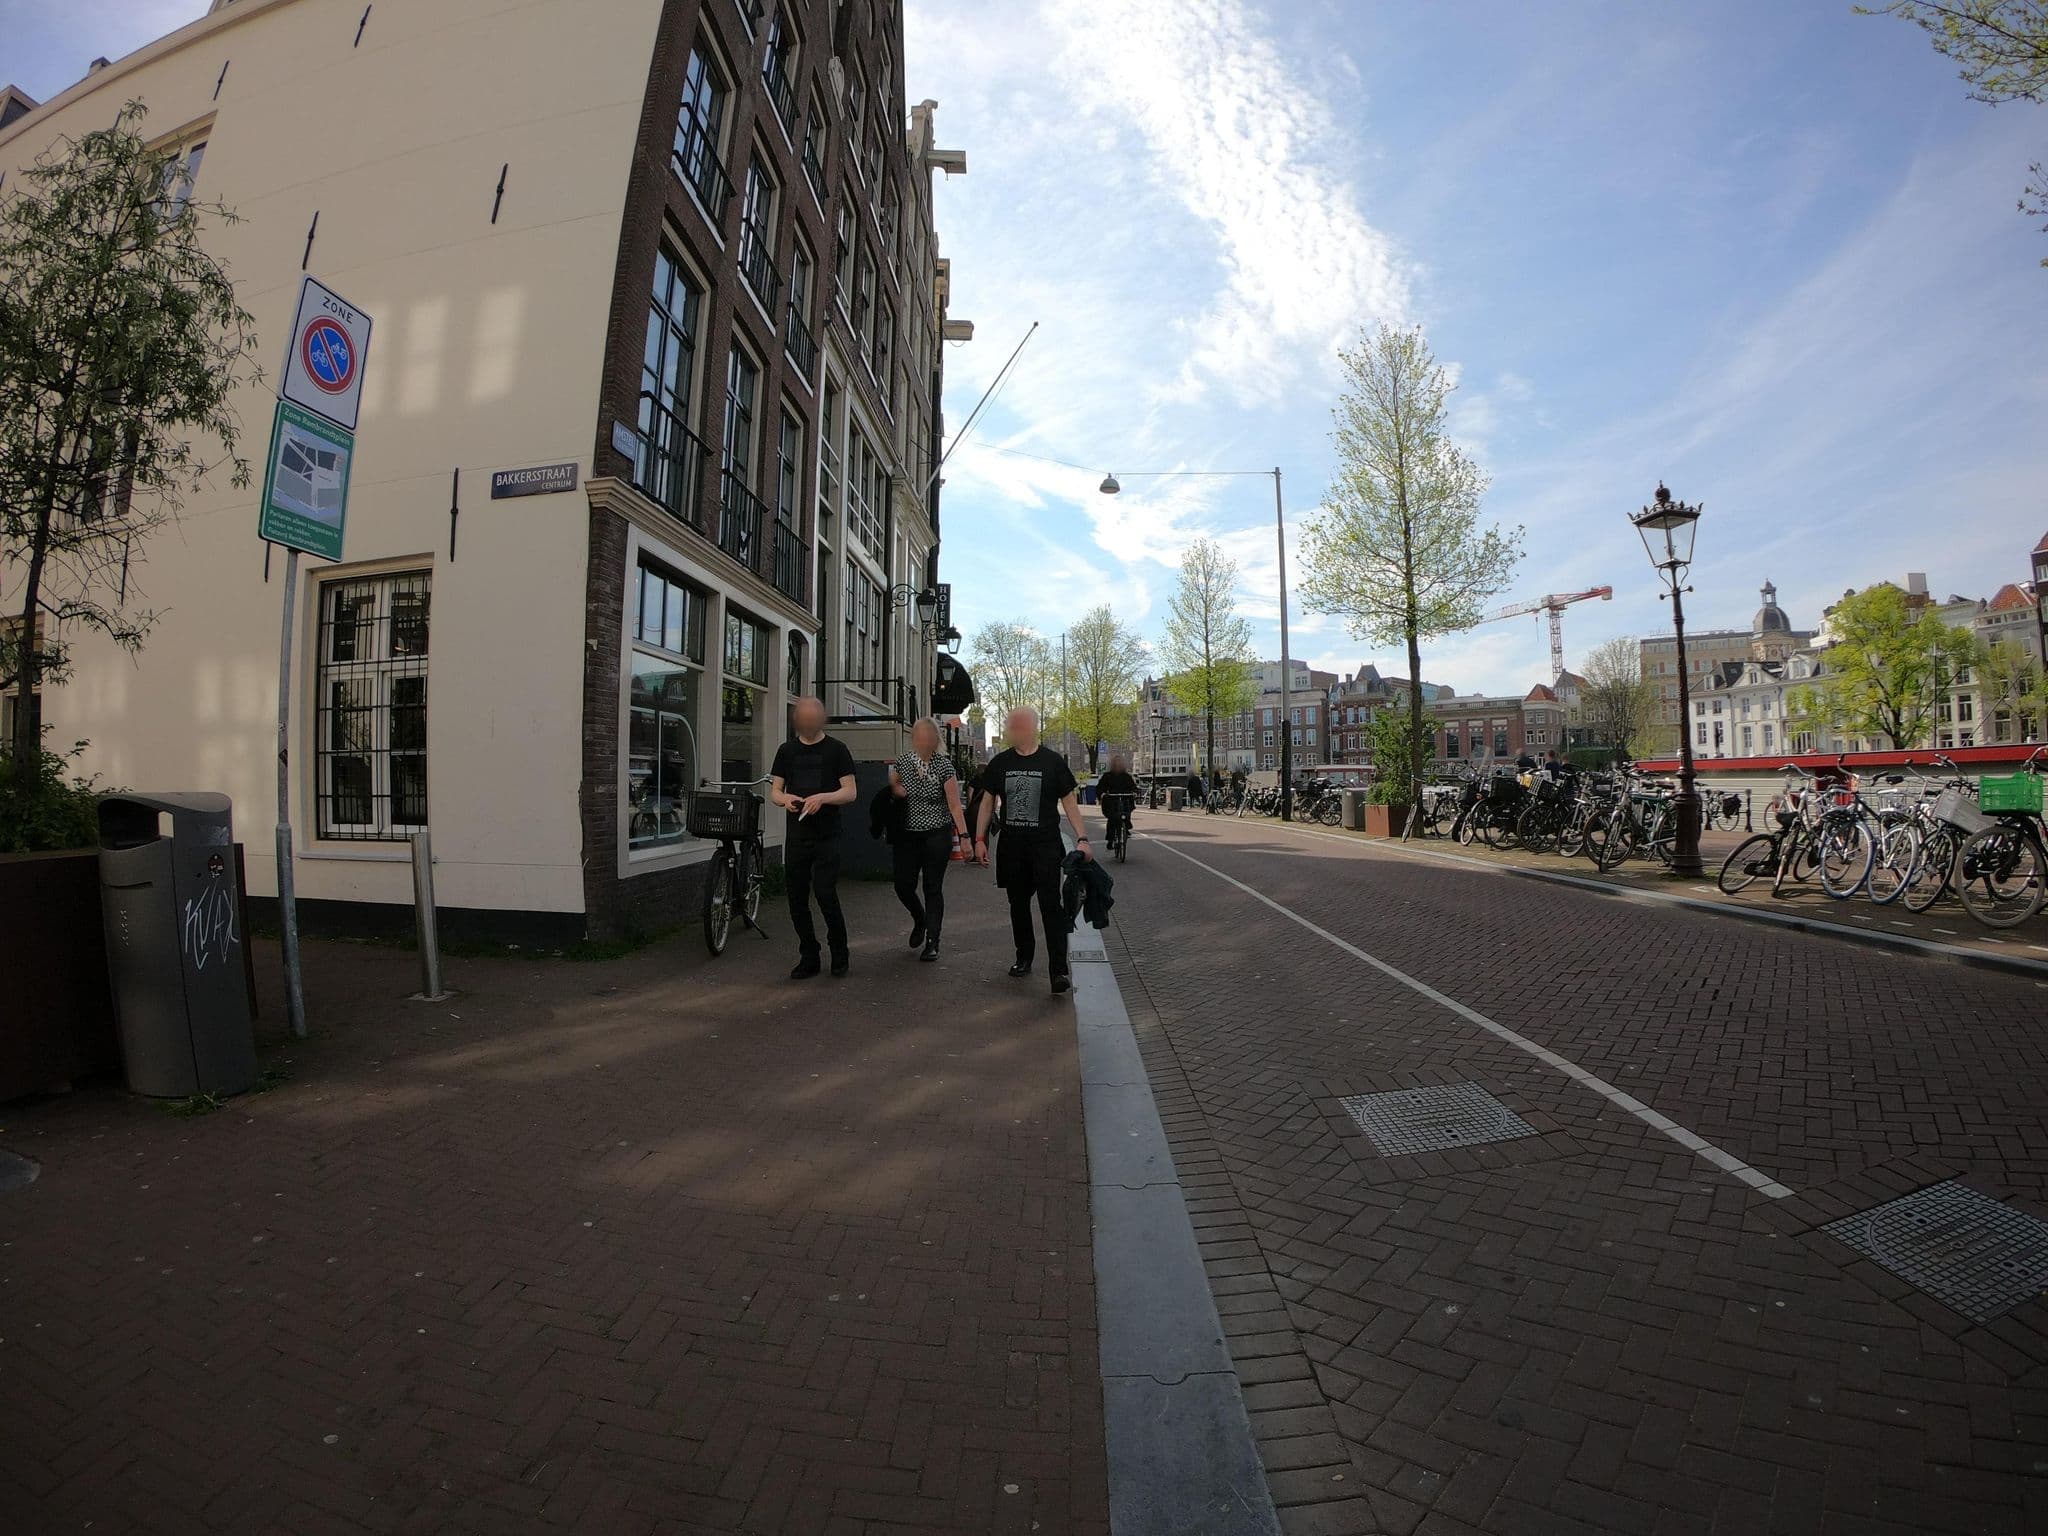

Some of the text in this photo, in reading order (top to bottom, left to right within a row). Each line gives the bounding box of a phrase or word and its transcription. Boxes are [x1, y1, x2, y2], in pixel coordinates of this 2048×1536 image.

[322, 296, 354, 325] ZONE
[496, 466, 573, 487] BAKKERSSTRAAT
[541, 480, 572, 490] CENTRUM
[939, 586, 947, 627] HOTEL
